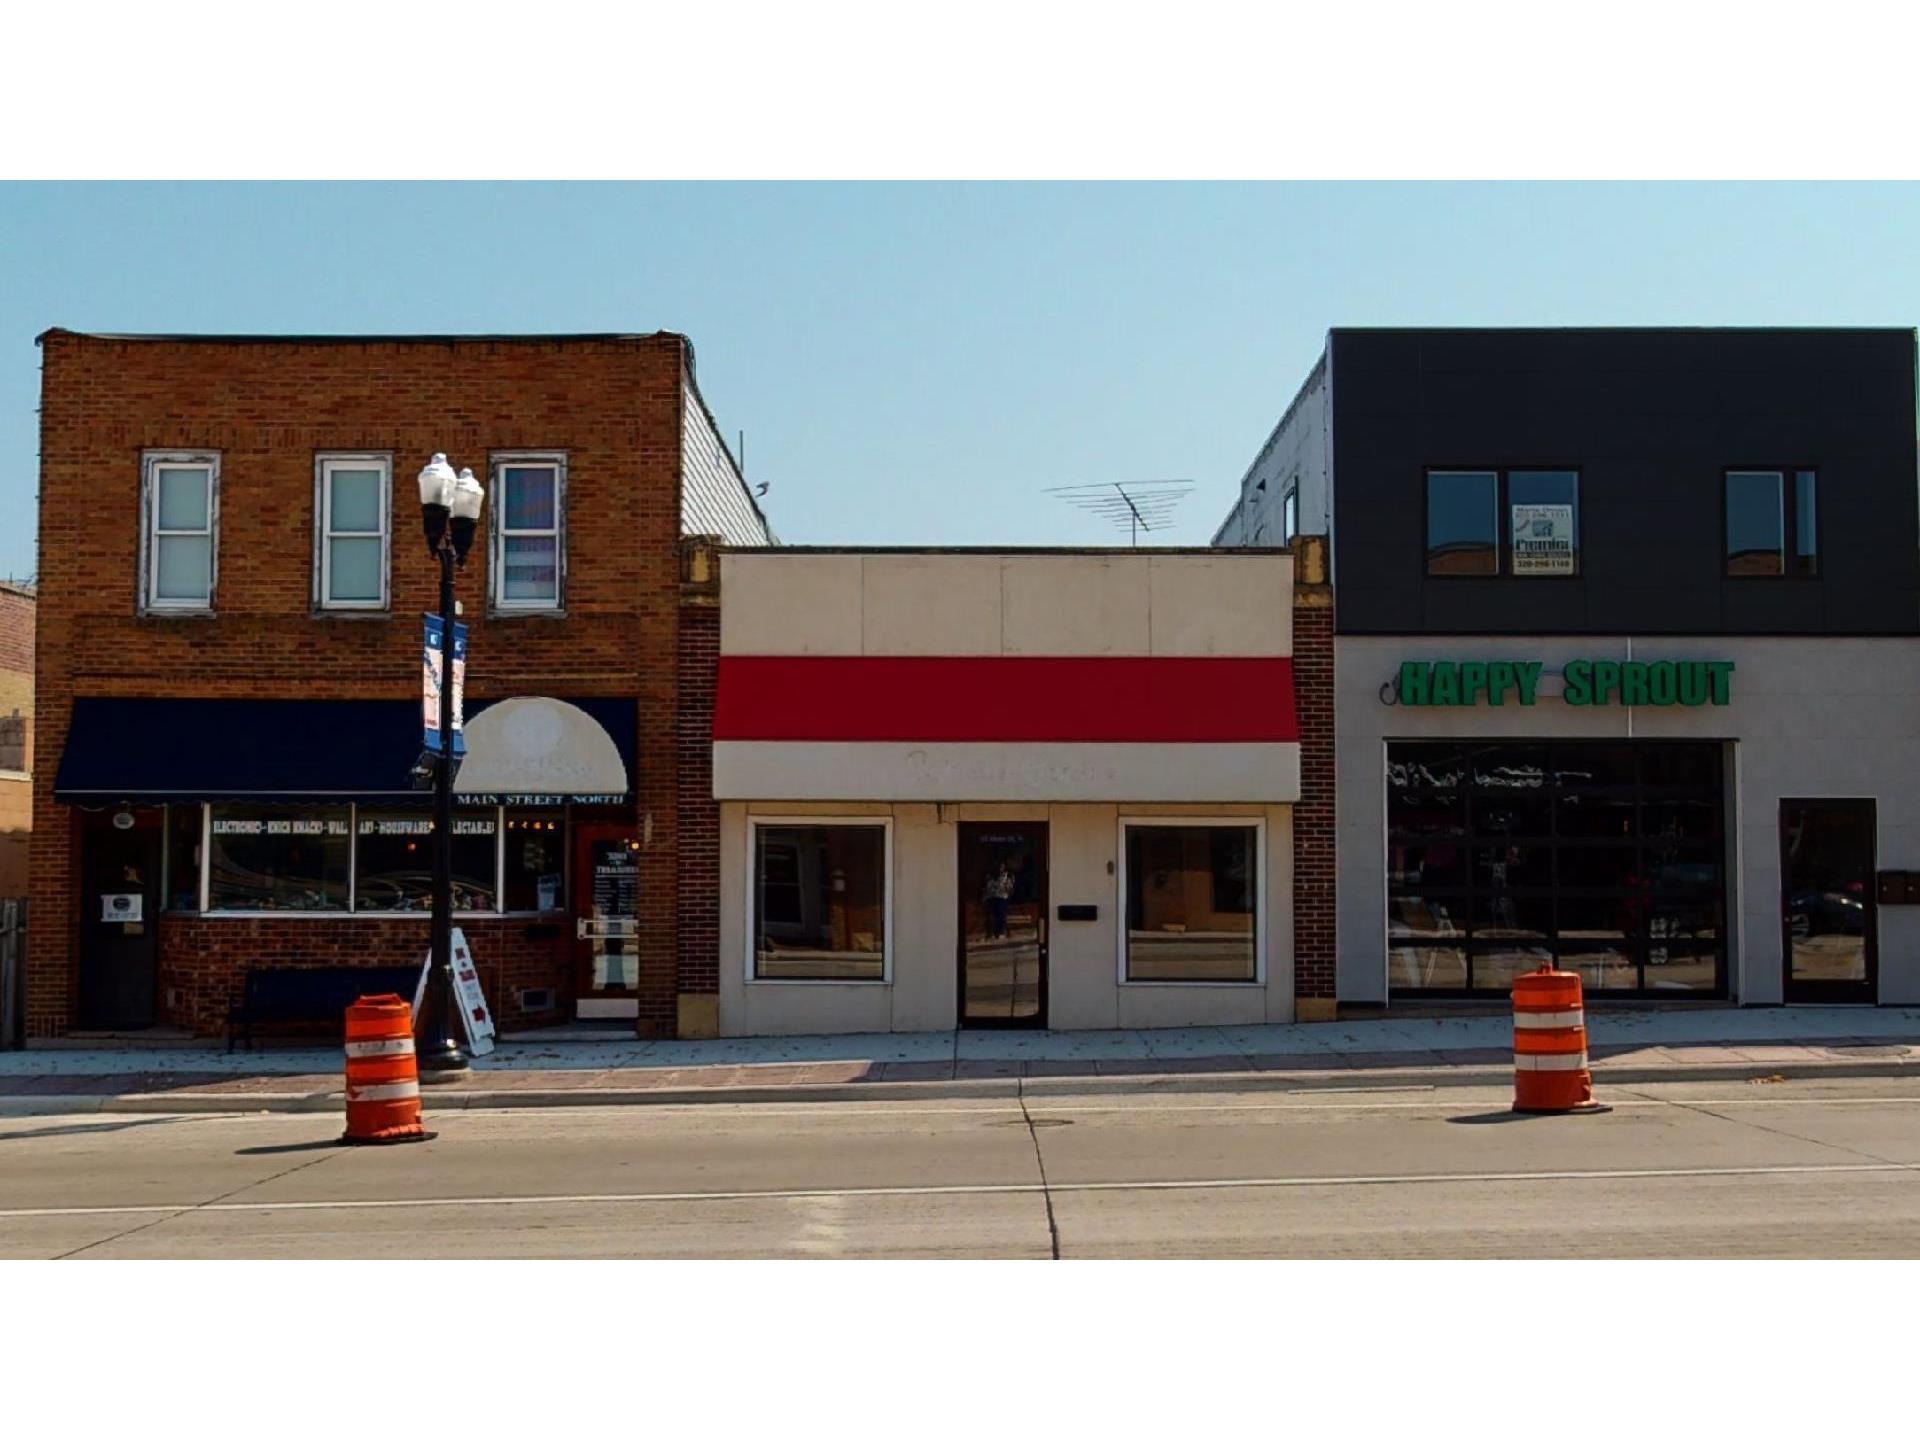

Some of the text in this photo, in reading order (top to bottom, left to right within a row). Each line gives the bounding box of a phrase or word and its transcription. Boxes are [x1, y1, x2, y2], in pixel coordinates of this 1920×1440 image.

[1399, 660, 1736, 707] HAPPY SPROUT
[457, 794, 625, 806] MAIN STREET NORTH
